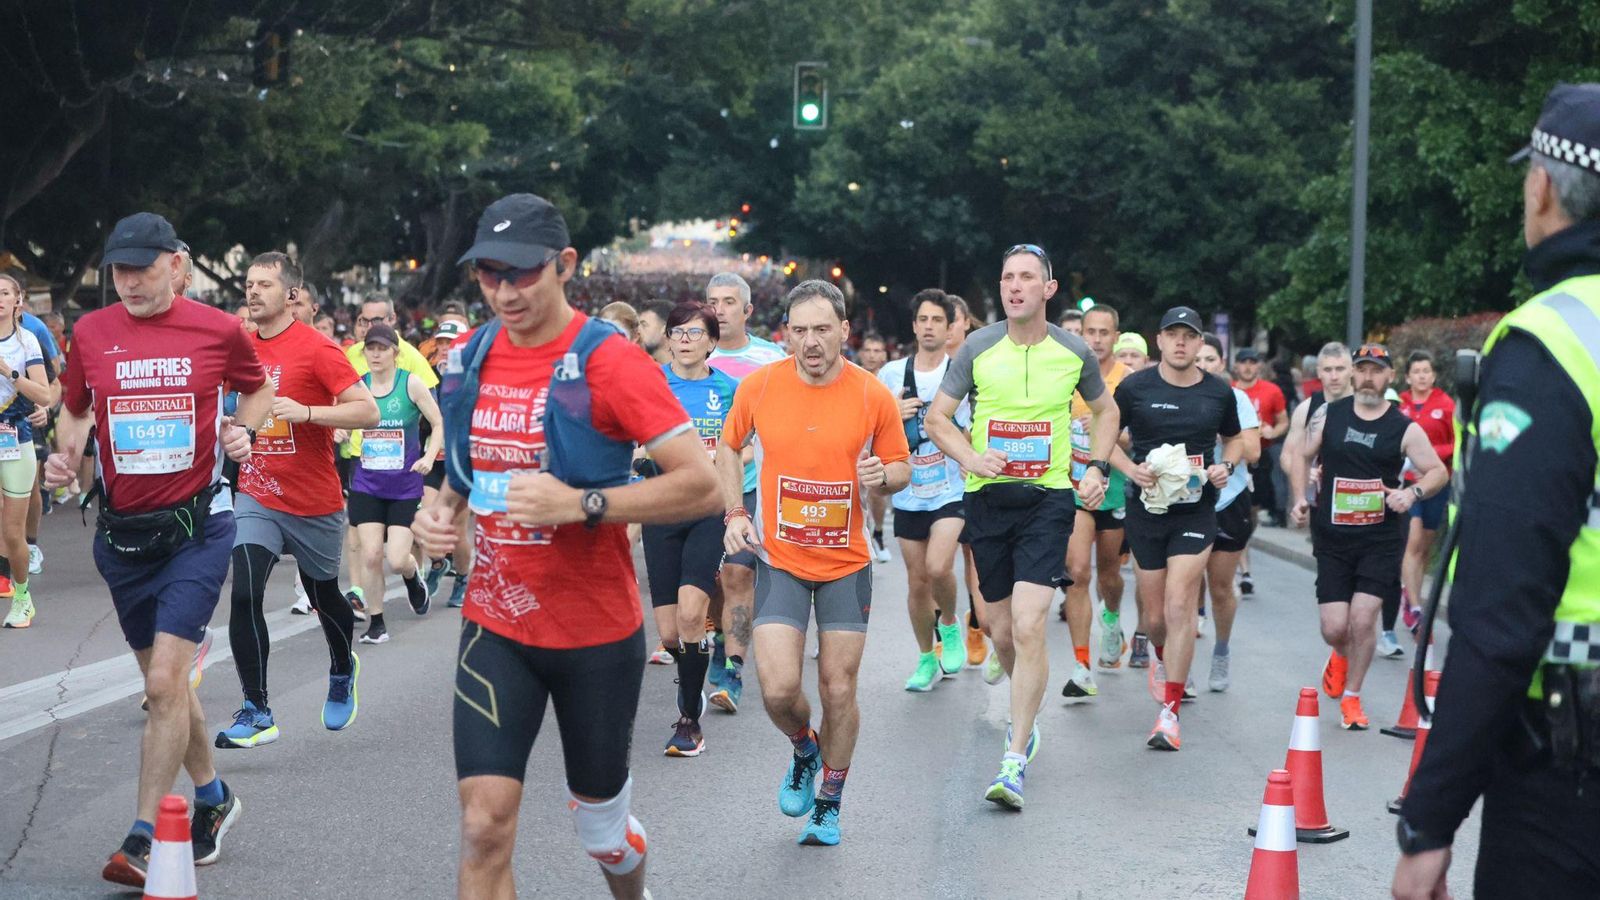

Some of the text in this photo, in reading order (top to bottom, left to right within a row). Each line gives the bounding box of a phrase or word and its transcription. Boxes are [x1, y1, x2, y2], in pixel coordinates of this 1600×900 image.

[115, 357, 192, 380] DUMFRIES
[120, 376, 188, 390] RUNNING CLUB
[130, 398, 187, 412] GENERALI
[471, 406, 527, 433] MÁLAGA
[127, 423, 176, 440] 16497
[1003, 422, 1047, 433] GENERALI
[477, 443, 537, 465] GENERAL
[1003, 441, 1035, 454] 5895
[800, 504, 828, 519] 493
